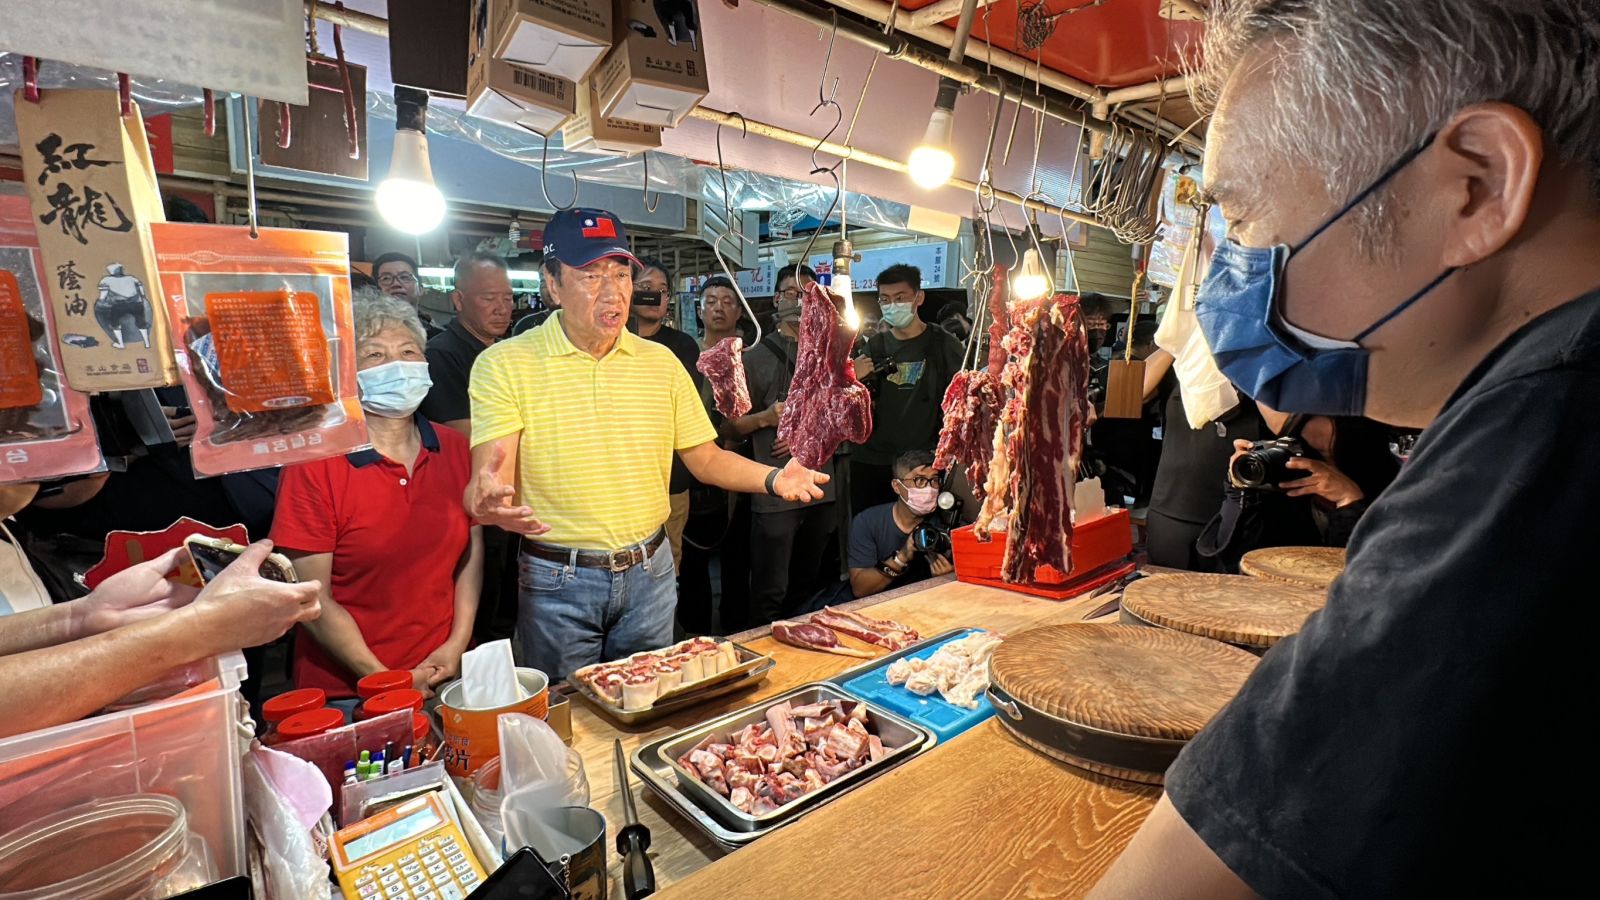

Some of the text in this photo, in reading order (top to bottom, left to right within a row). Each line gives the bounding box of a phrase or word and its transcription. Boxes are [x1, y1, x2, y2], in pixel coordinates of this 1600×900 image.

[36, 132, 133, 245] 紅龍
[56, 260, 87, 317] 蔭油
[851, 279, 878, 290] EL:234
